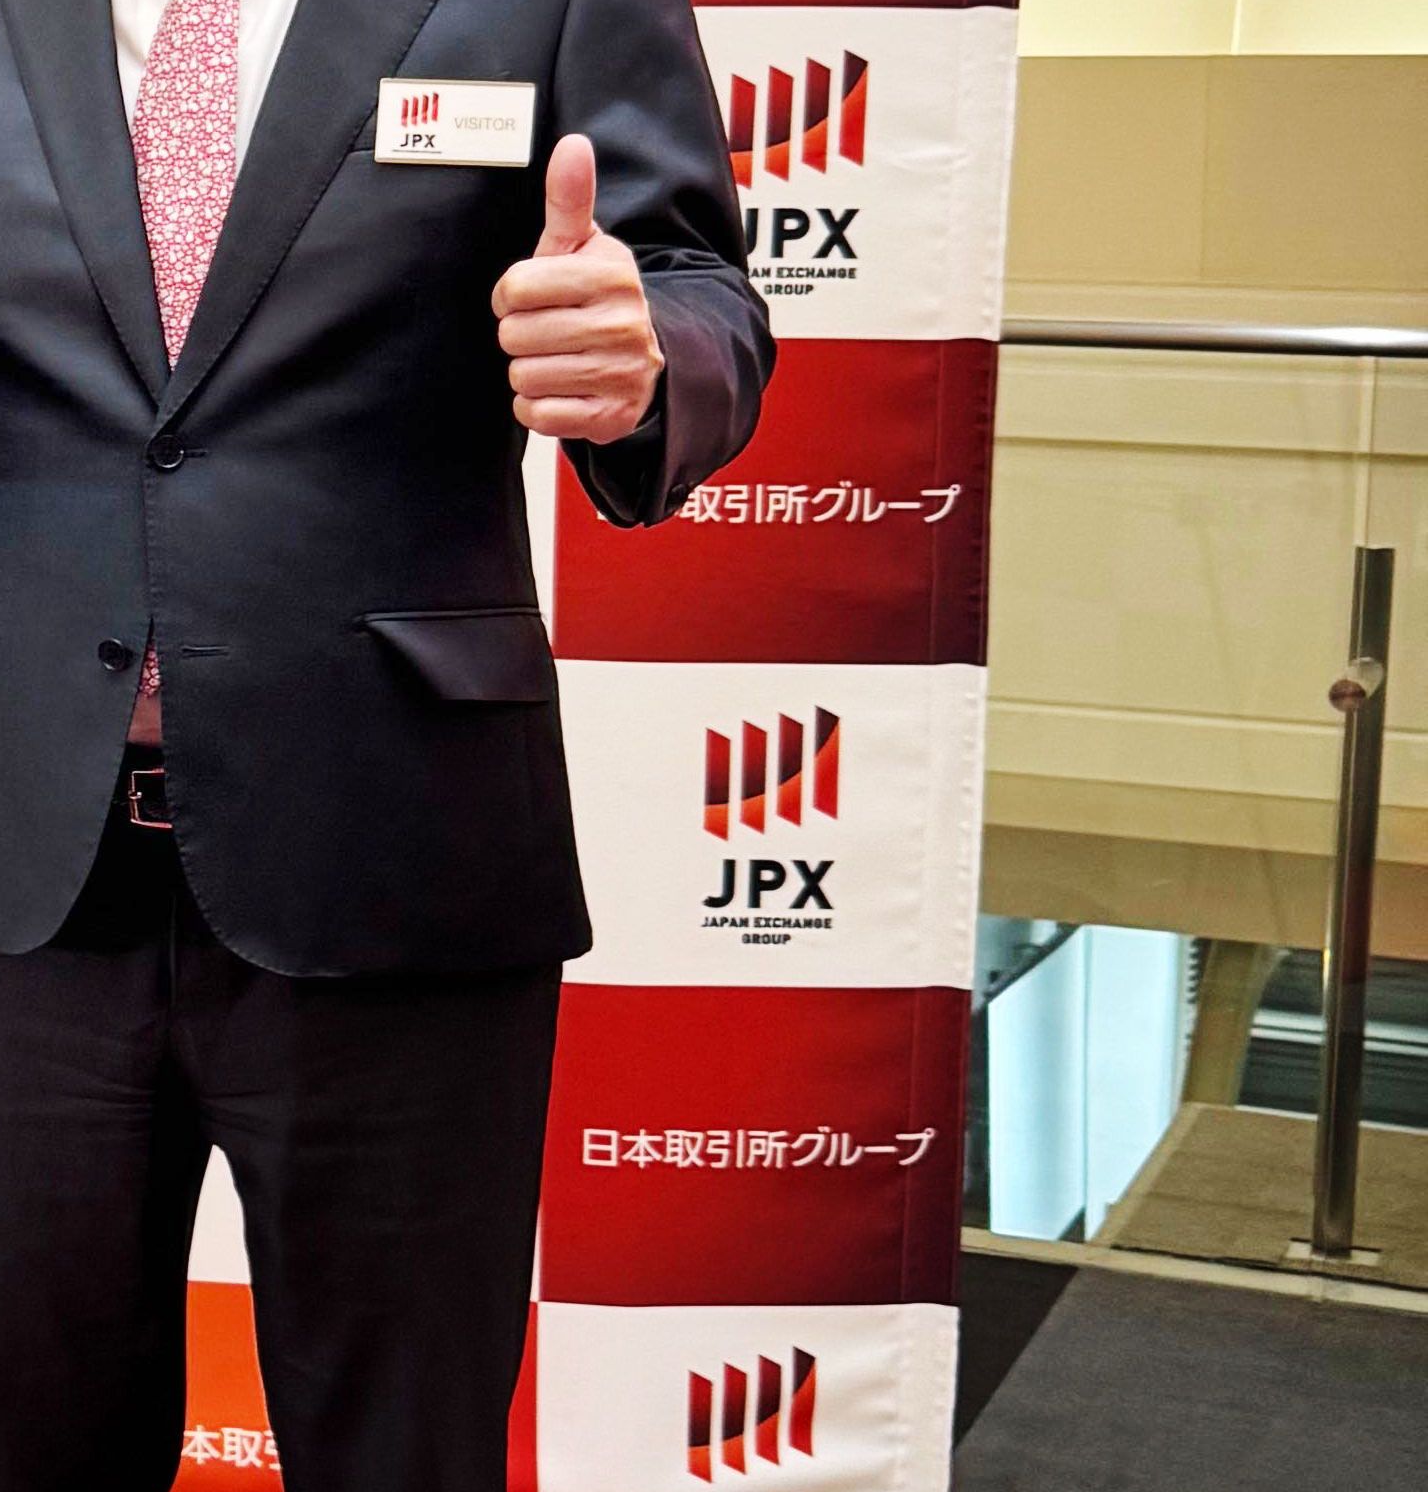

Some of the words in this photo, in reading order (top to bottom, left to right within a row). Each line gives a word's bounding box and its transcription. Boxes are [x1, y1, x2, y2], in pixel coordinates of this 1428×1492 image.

[454, 117, 516, 131] VISITOR
[400, 134, 436, 149] JPX
[775, 267, 857, 279] EXCHANGE
[763, 283, 815, 295] GROUP
[703, 858, 834, 910] JPX
[700, 916, 750, 930] JAPAN
[752, 916, 833, 930] EXCHANGE
[741, 932, 792, 946] GROUP
[583, 1126, 935, 1168] 日本取引所グループ
